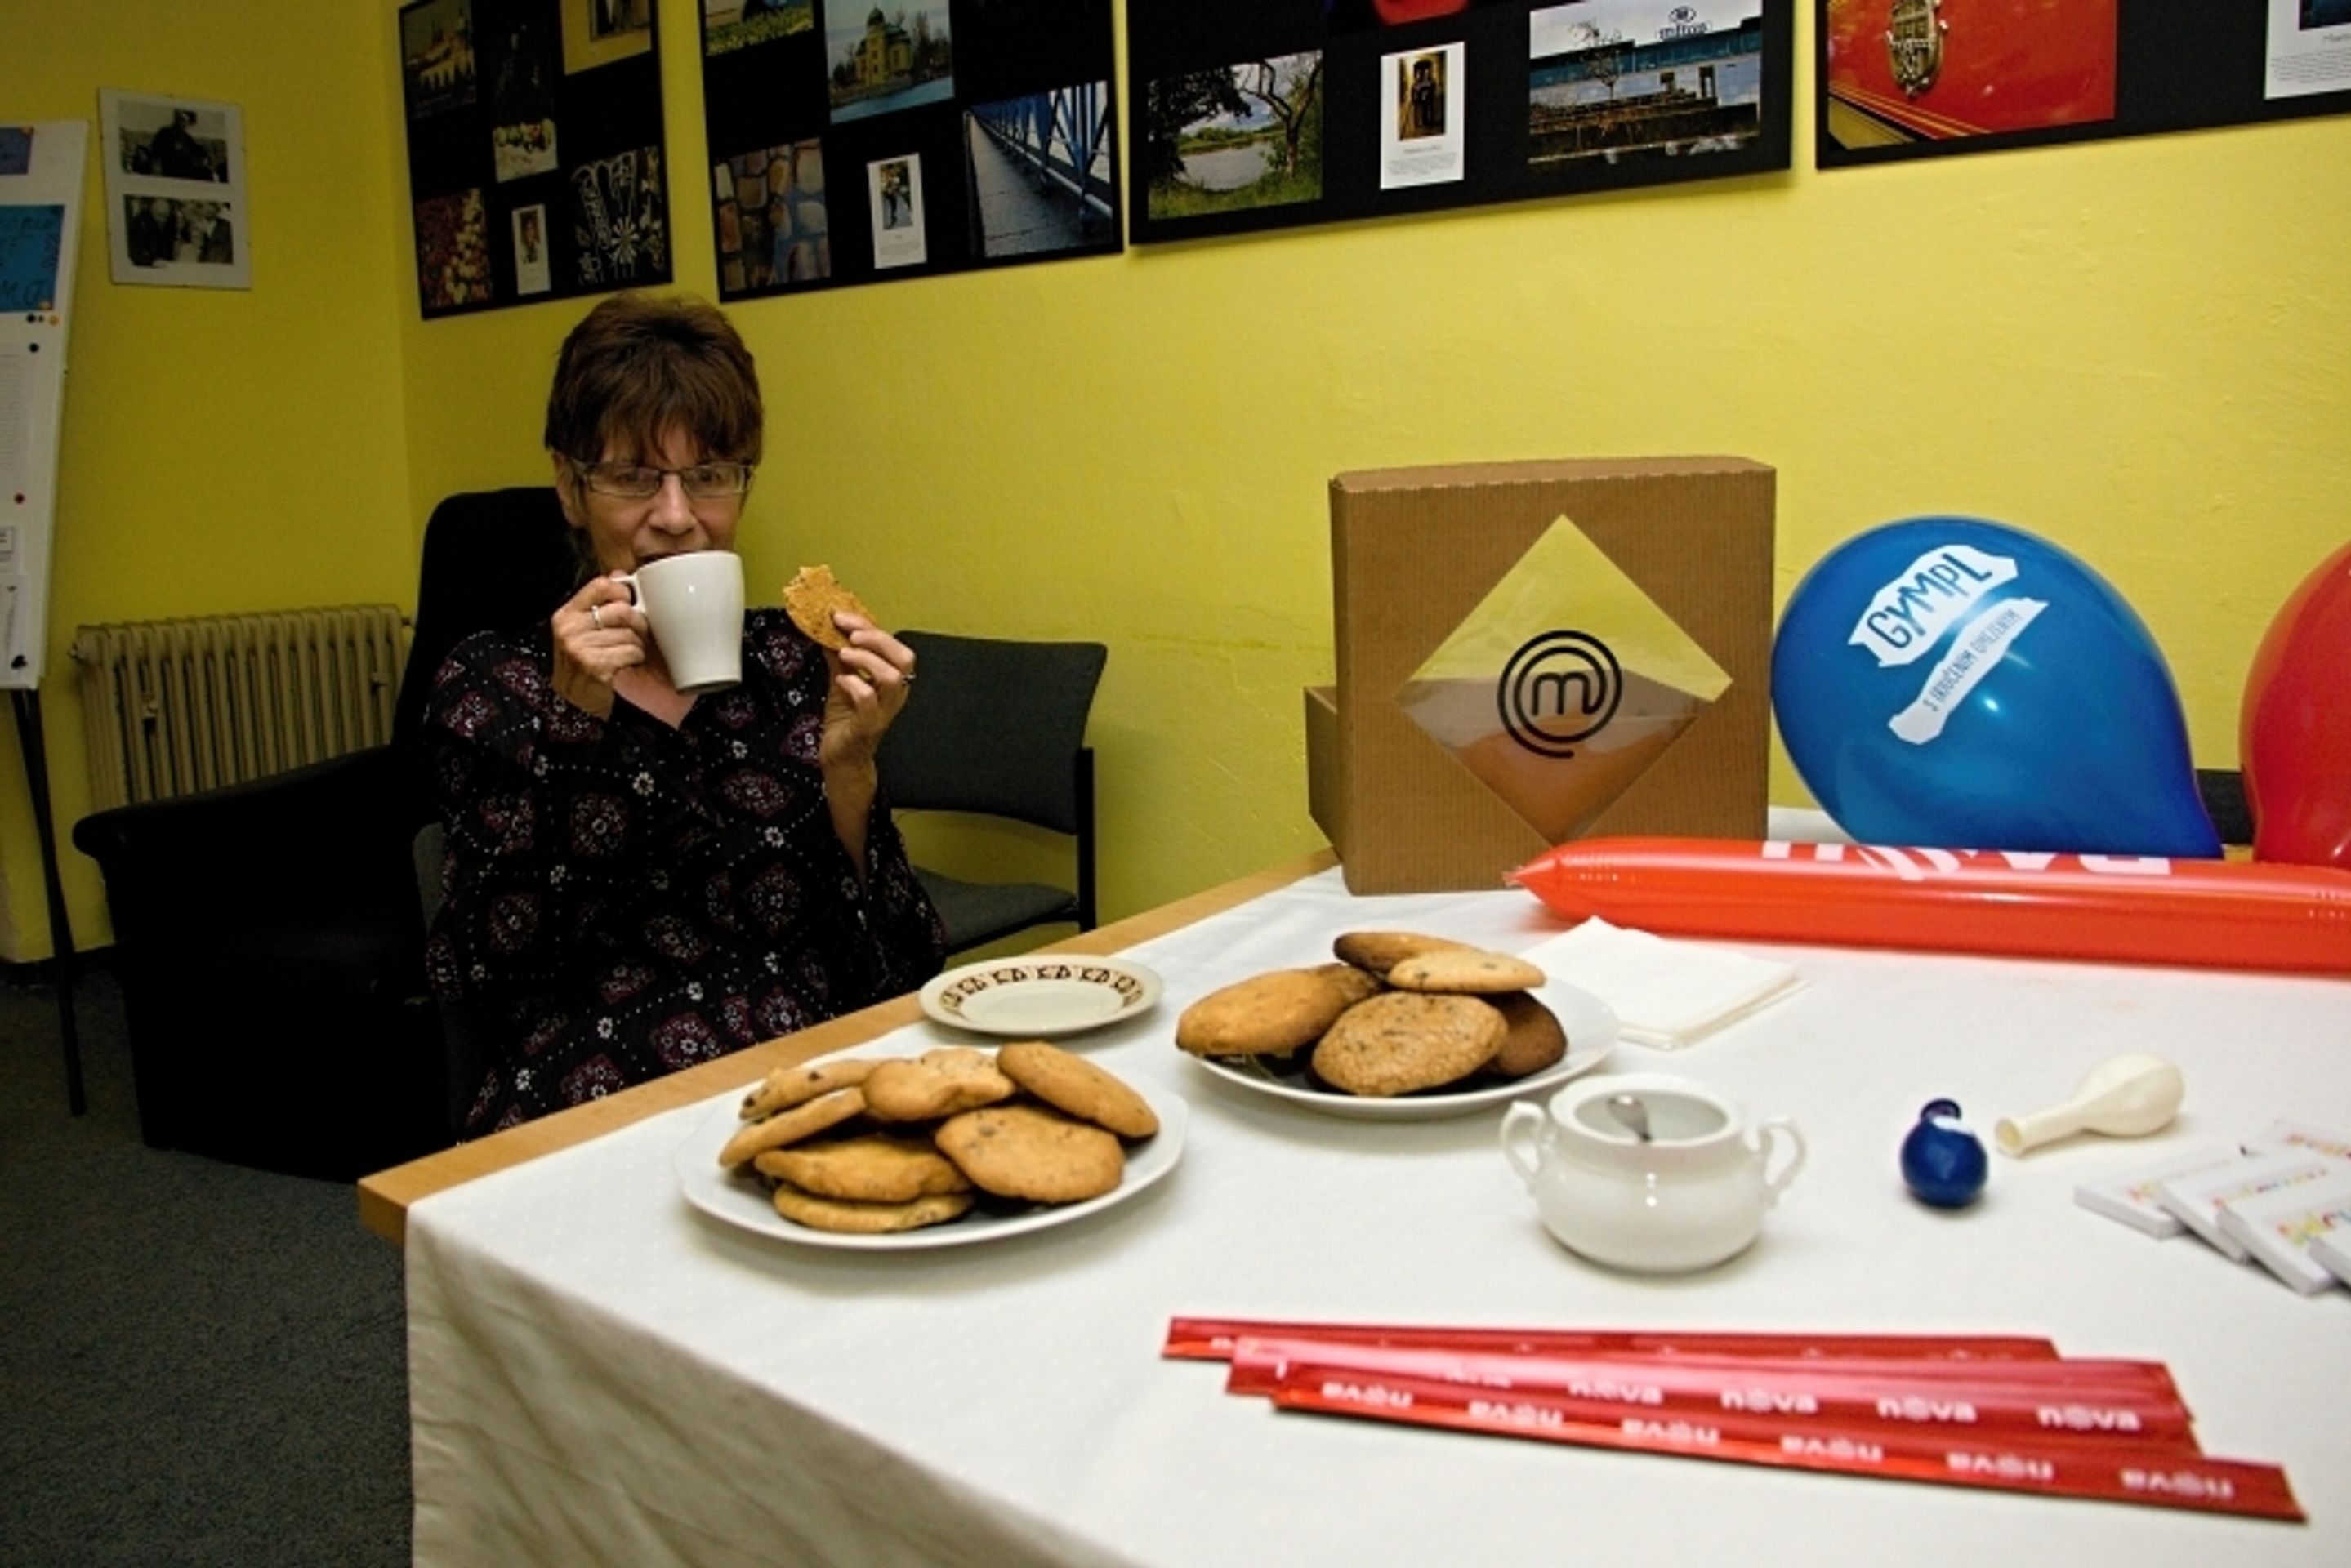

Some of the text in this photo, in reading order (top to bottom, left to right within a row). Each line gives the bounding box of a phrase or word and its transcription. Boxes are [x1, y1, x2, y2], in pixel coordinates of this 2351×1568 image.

[1867, 553, 1993, 649] GYMPL
[1568, 1379, 2142, 1432] nova nova nova nova
